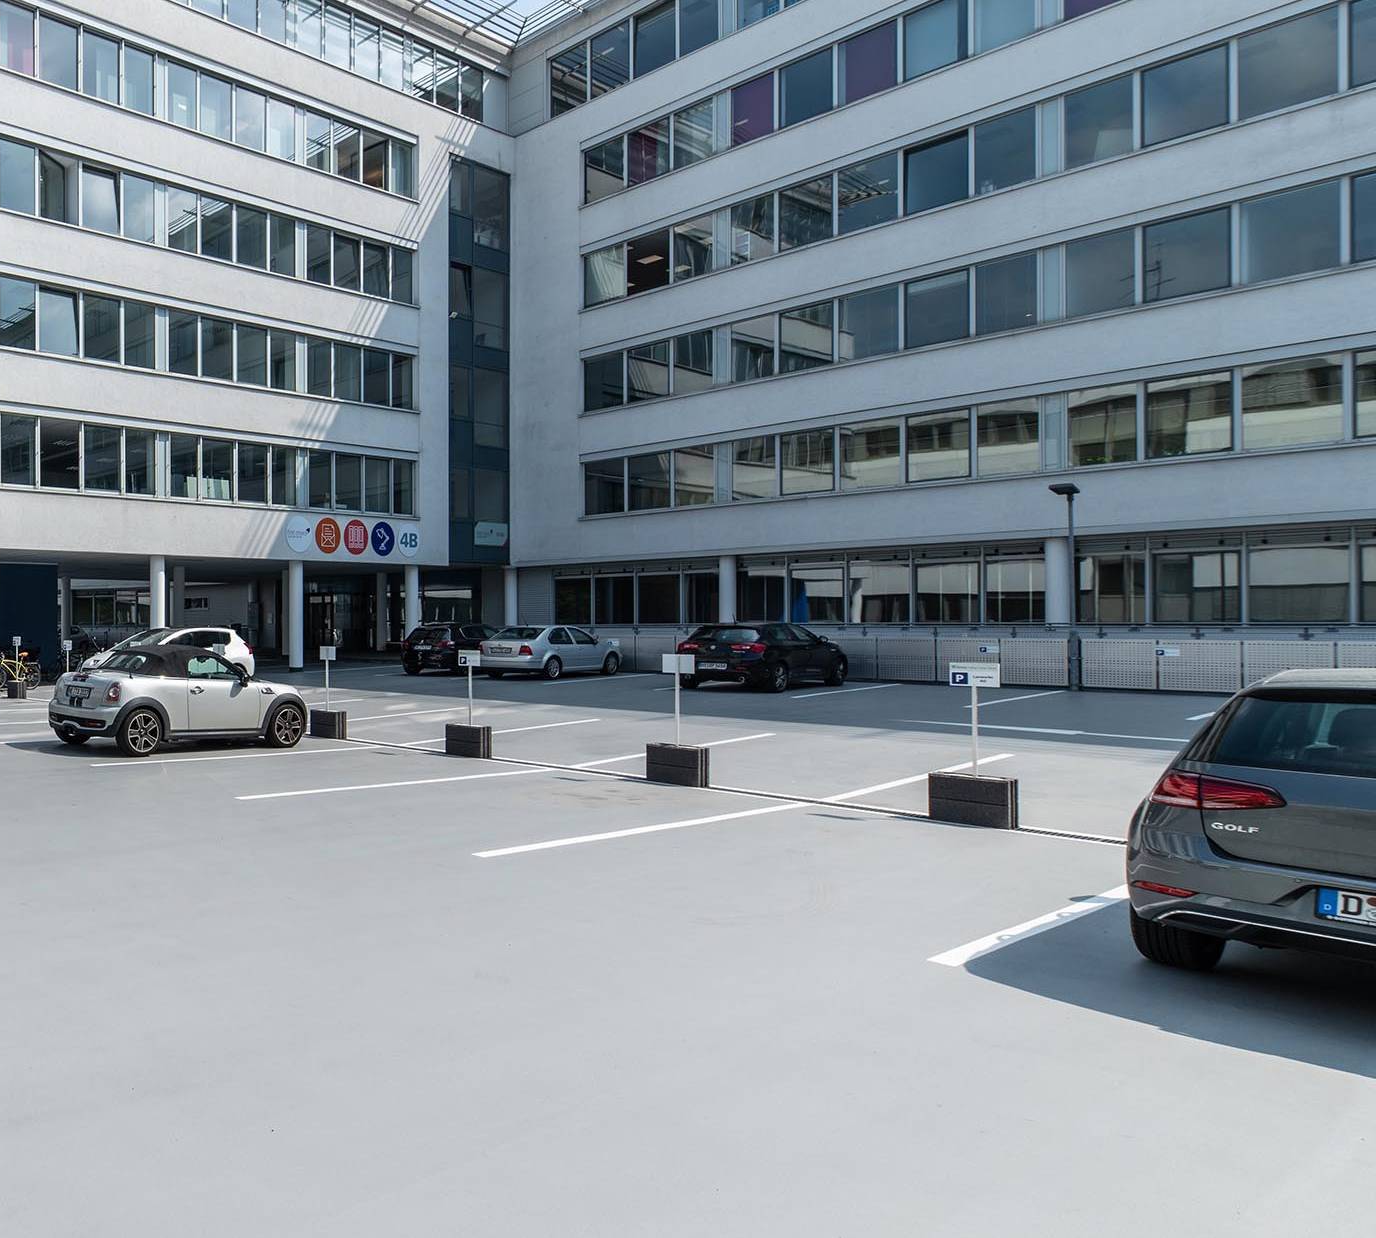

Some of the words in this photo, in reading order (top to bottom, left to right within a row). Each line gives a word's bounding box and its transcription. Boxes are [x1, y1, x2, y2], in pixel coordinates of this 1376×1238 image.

[400, 532, 418, 548] 4B
[955, 674, 965, 683] P
[1211, 822, 1259, 833] GOLF
[1341, 894, 1362, 916] D
